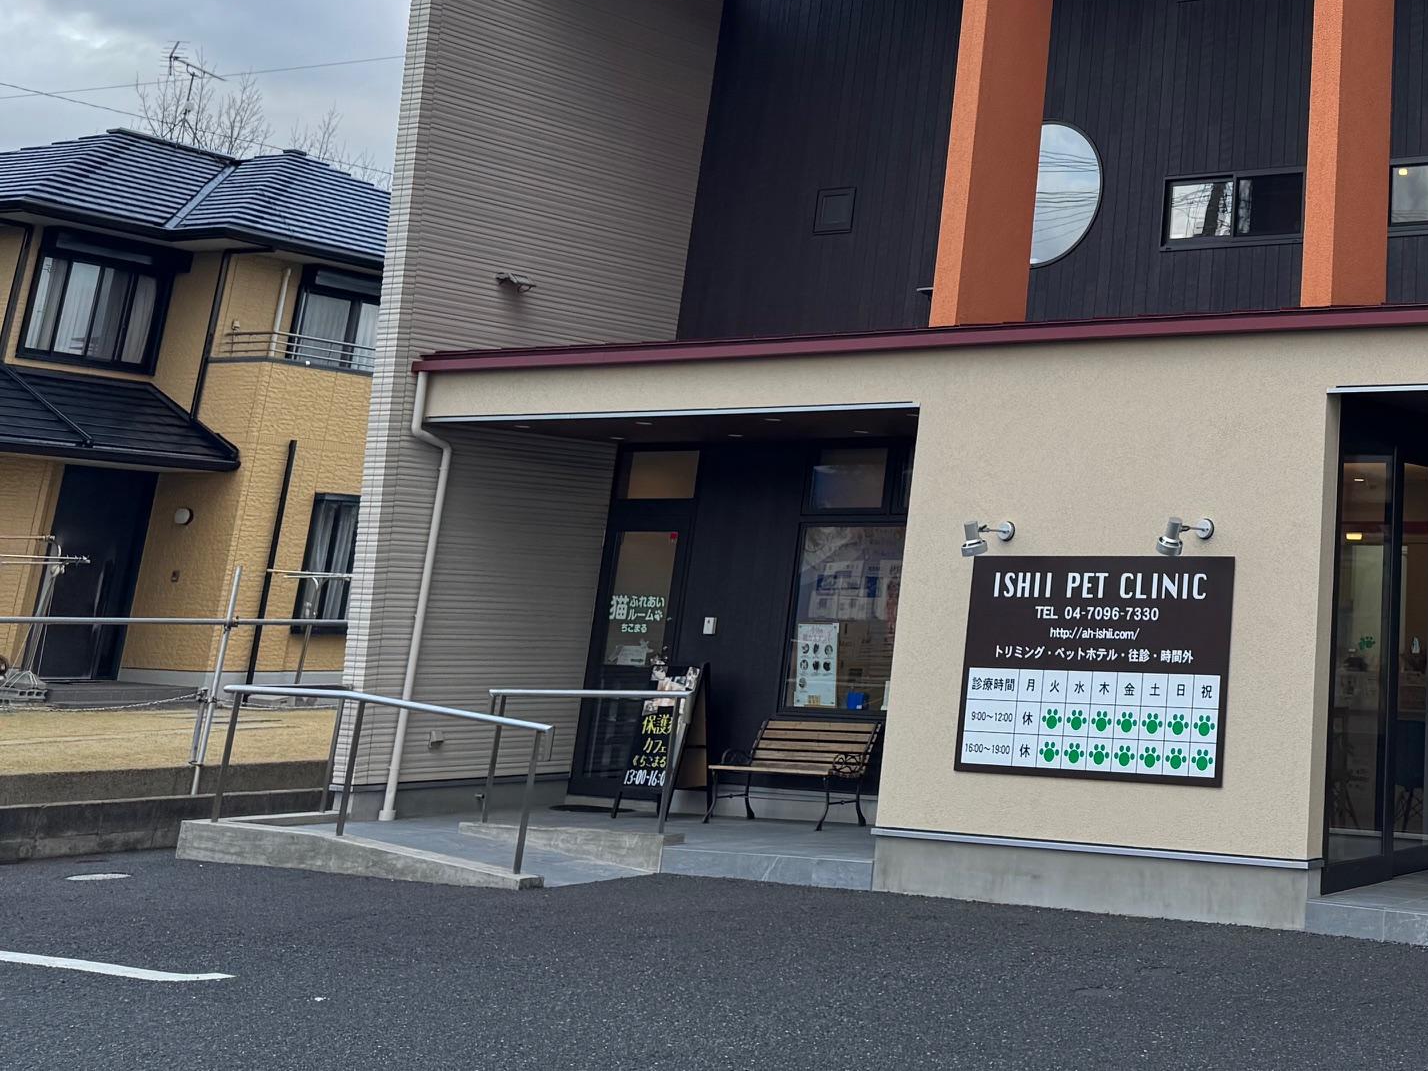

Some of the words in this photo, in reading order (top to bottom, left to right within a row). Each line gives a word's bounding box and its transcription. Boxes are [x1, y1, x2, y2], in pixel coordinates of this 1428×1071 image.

[993, 572, 1052, 598] ISHII
[1066, 572, 1109, 599] PET
[1119, 572, 1208, 600] CLINIC
[608, 594, 629, 620] 猫
[629, 595, 665, 608] ふれあい
[1035, 606, 1058, 619] TEL
[1064, 606, 1160, 621] 04-7096-7330
[627, 609, 654, 621] ルーム
[621, 623, 648, 633] ちこまる
[1050, 627, 1140, 640] http://ah-ishii.com/
[971, 677, 1015, 692] 診療時間
[1026, 679, 1035, 692] 月
[1049, 680, 1060, 692] 火
[1074, 680, 1085, 693] 水
[1099, 681, 1110, 694] 木
[1124, 682, 1135, 695] 金
[1149, 683, 1161, 696] 土
[1176, 684, 1186, 696] 日
[1201, 684, 1212, 698] 祝
[641, 714, 673, 735] 保護
[1022, 713, 1033, 725] 休
[643, 737, 667, 753] カフェ
[1019, 744, 1030, 757] 休
